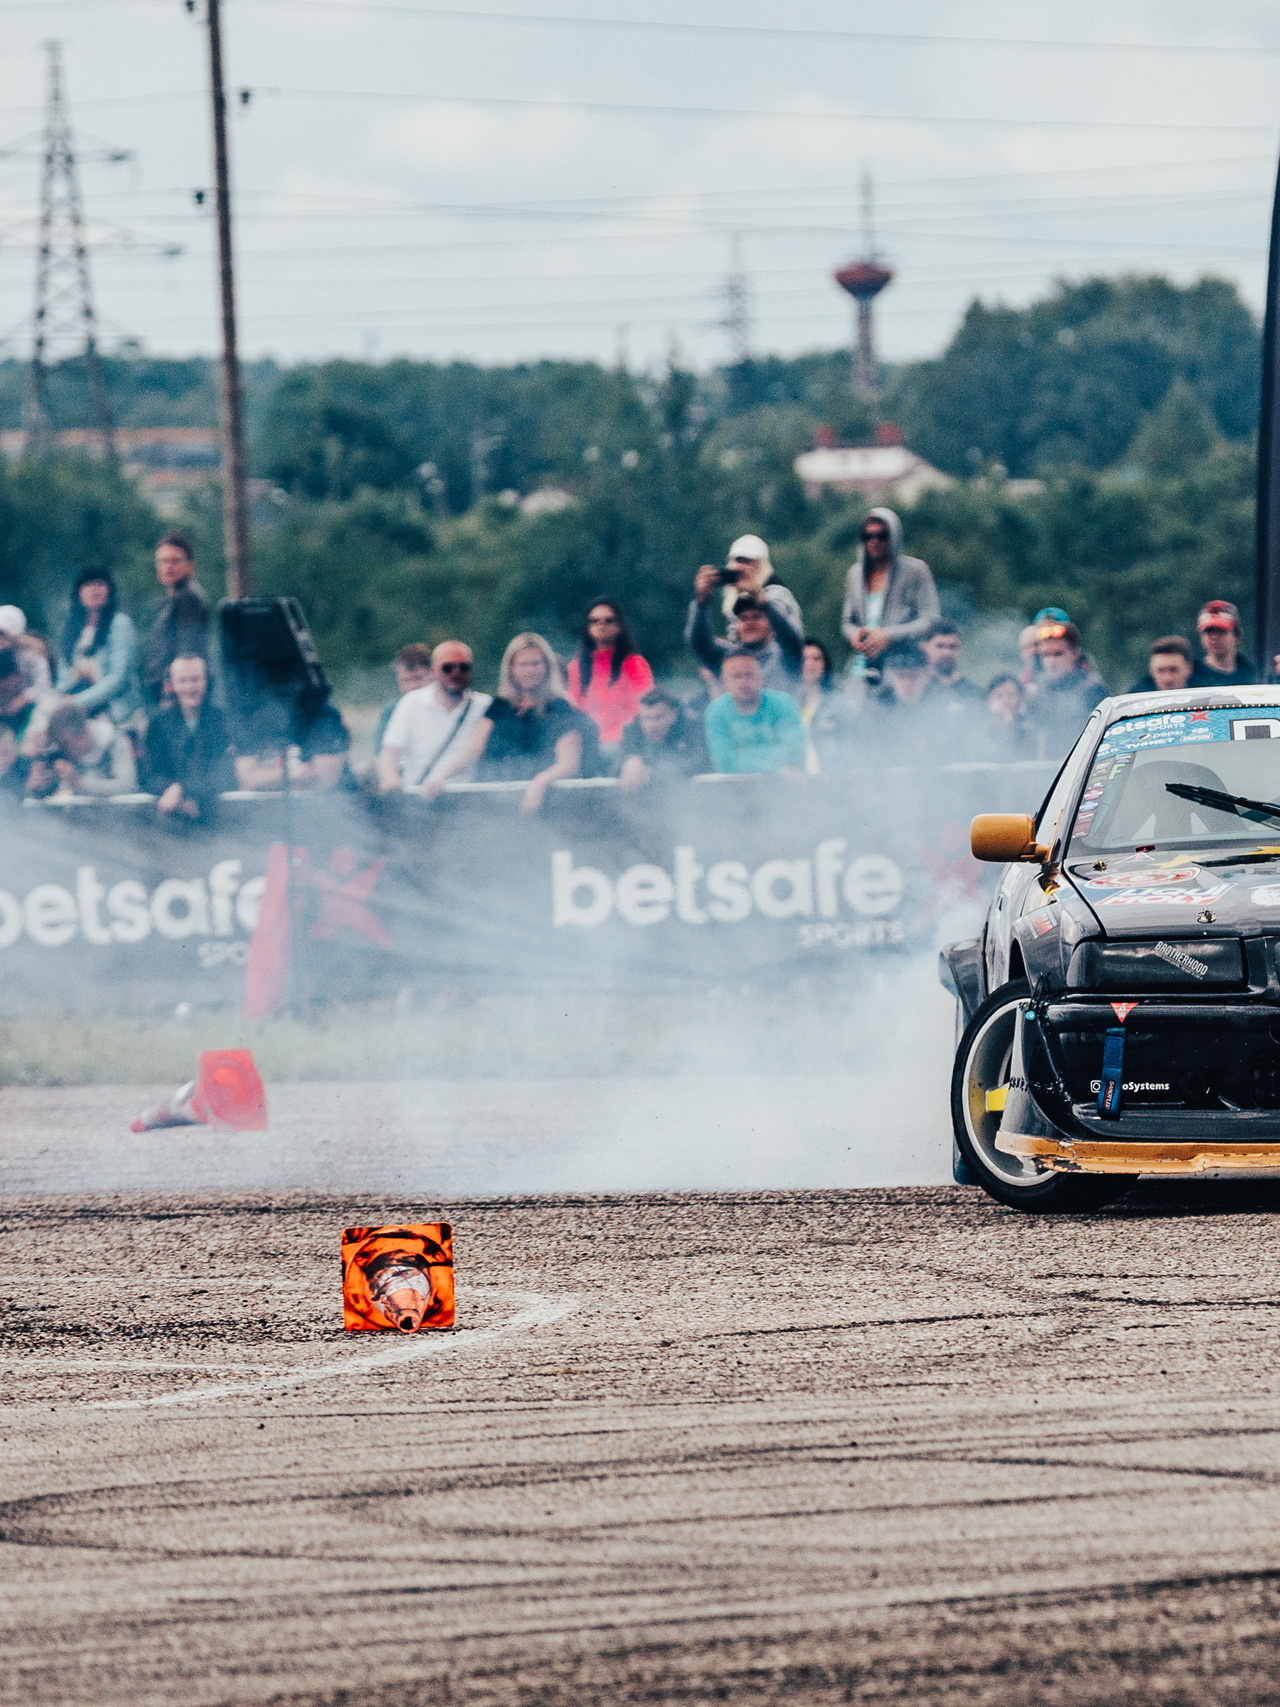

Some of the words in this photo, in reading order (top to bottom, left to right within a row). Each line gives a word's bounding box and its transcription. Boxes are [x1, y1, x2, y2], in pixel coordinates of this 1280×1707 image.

[553, 838, 903, 929] betsafe
[1117, 883, 1230, 896] LIQUI
[1102, 895, 1210, 905] MOLY
[799, 920, 904, 947] SPORTS
[1154, 941, 1209, 976] BROTHERHOOD
